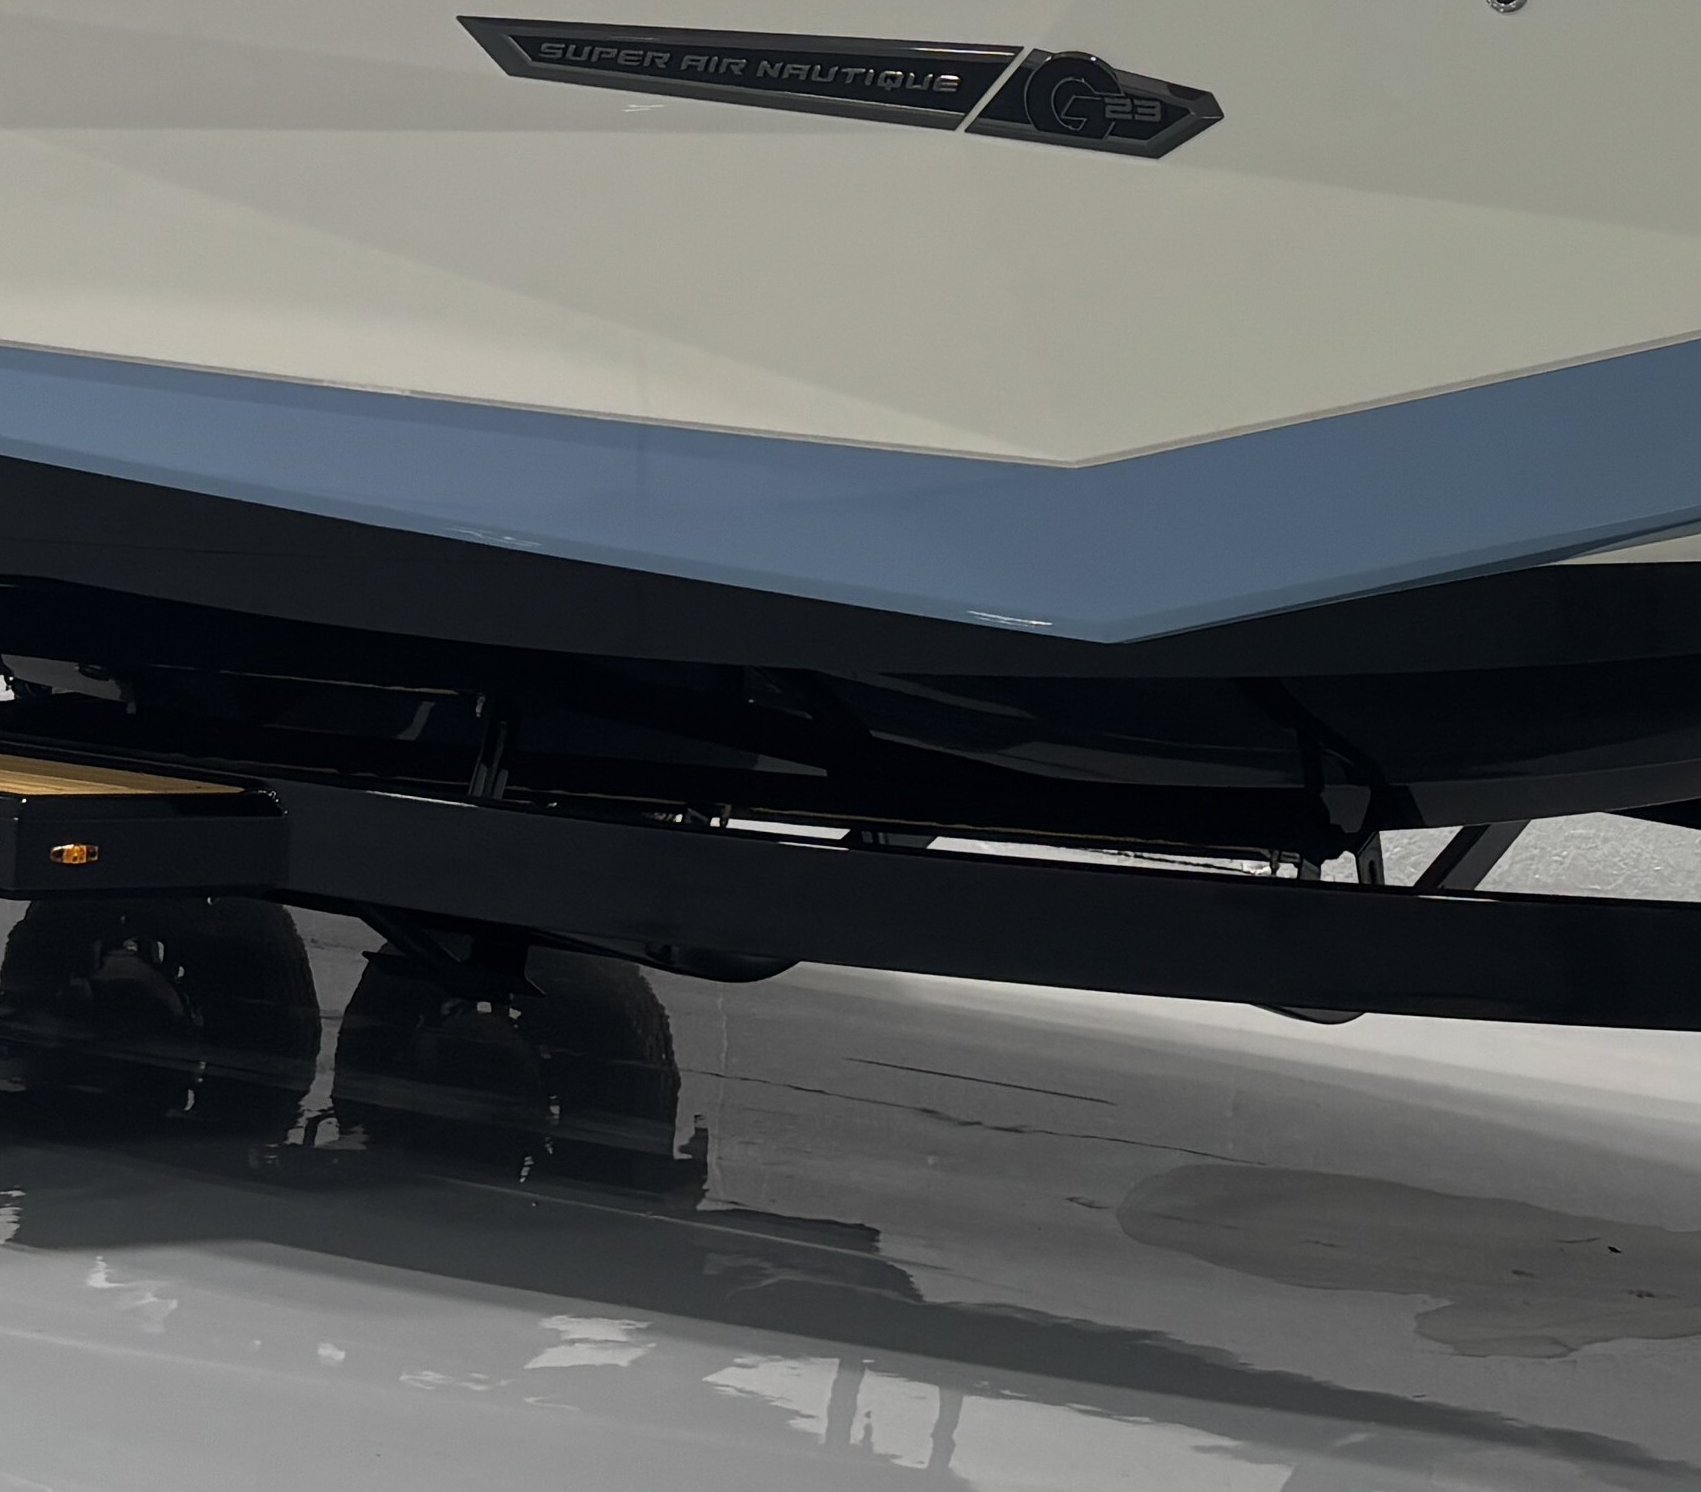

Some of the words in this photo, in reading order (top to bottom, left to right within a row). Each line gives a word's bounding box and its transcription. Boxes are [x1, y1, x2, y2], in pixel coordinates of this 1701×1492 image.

[538, 43, 671, 69] SUPER
[680, 55, 747, 75] AIR
[756, 60, 961, 92] NAUTIQUE
